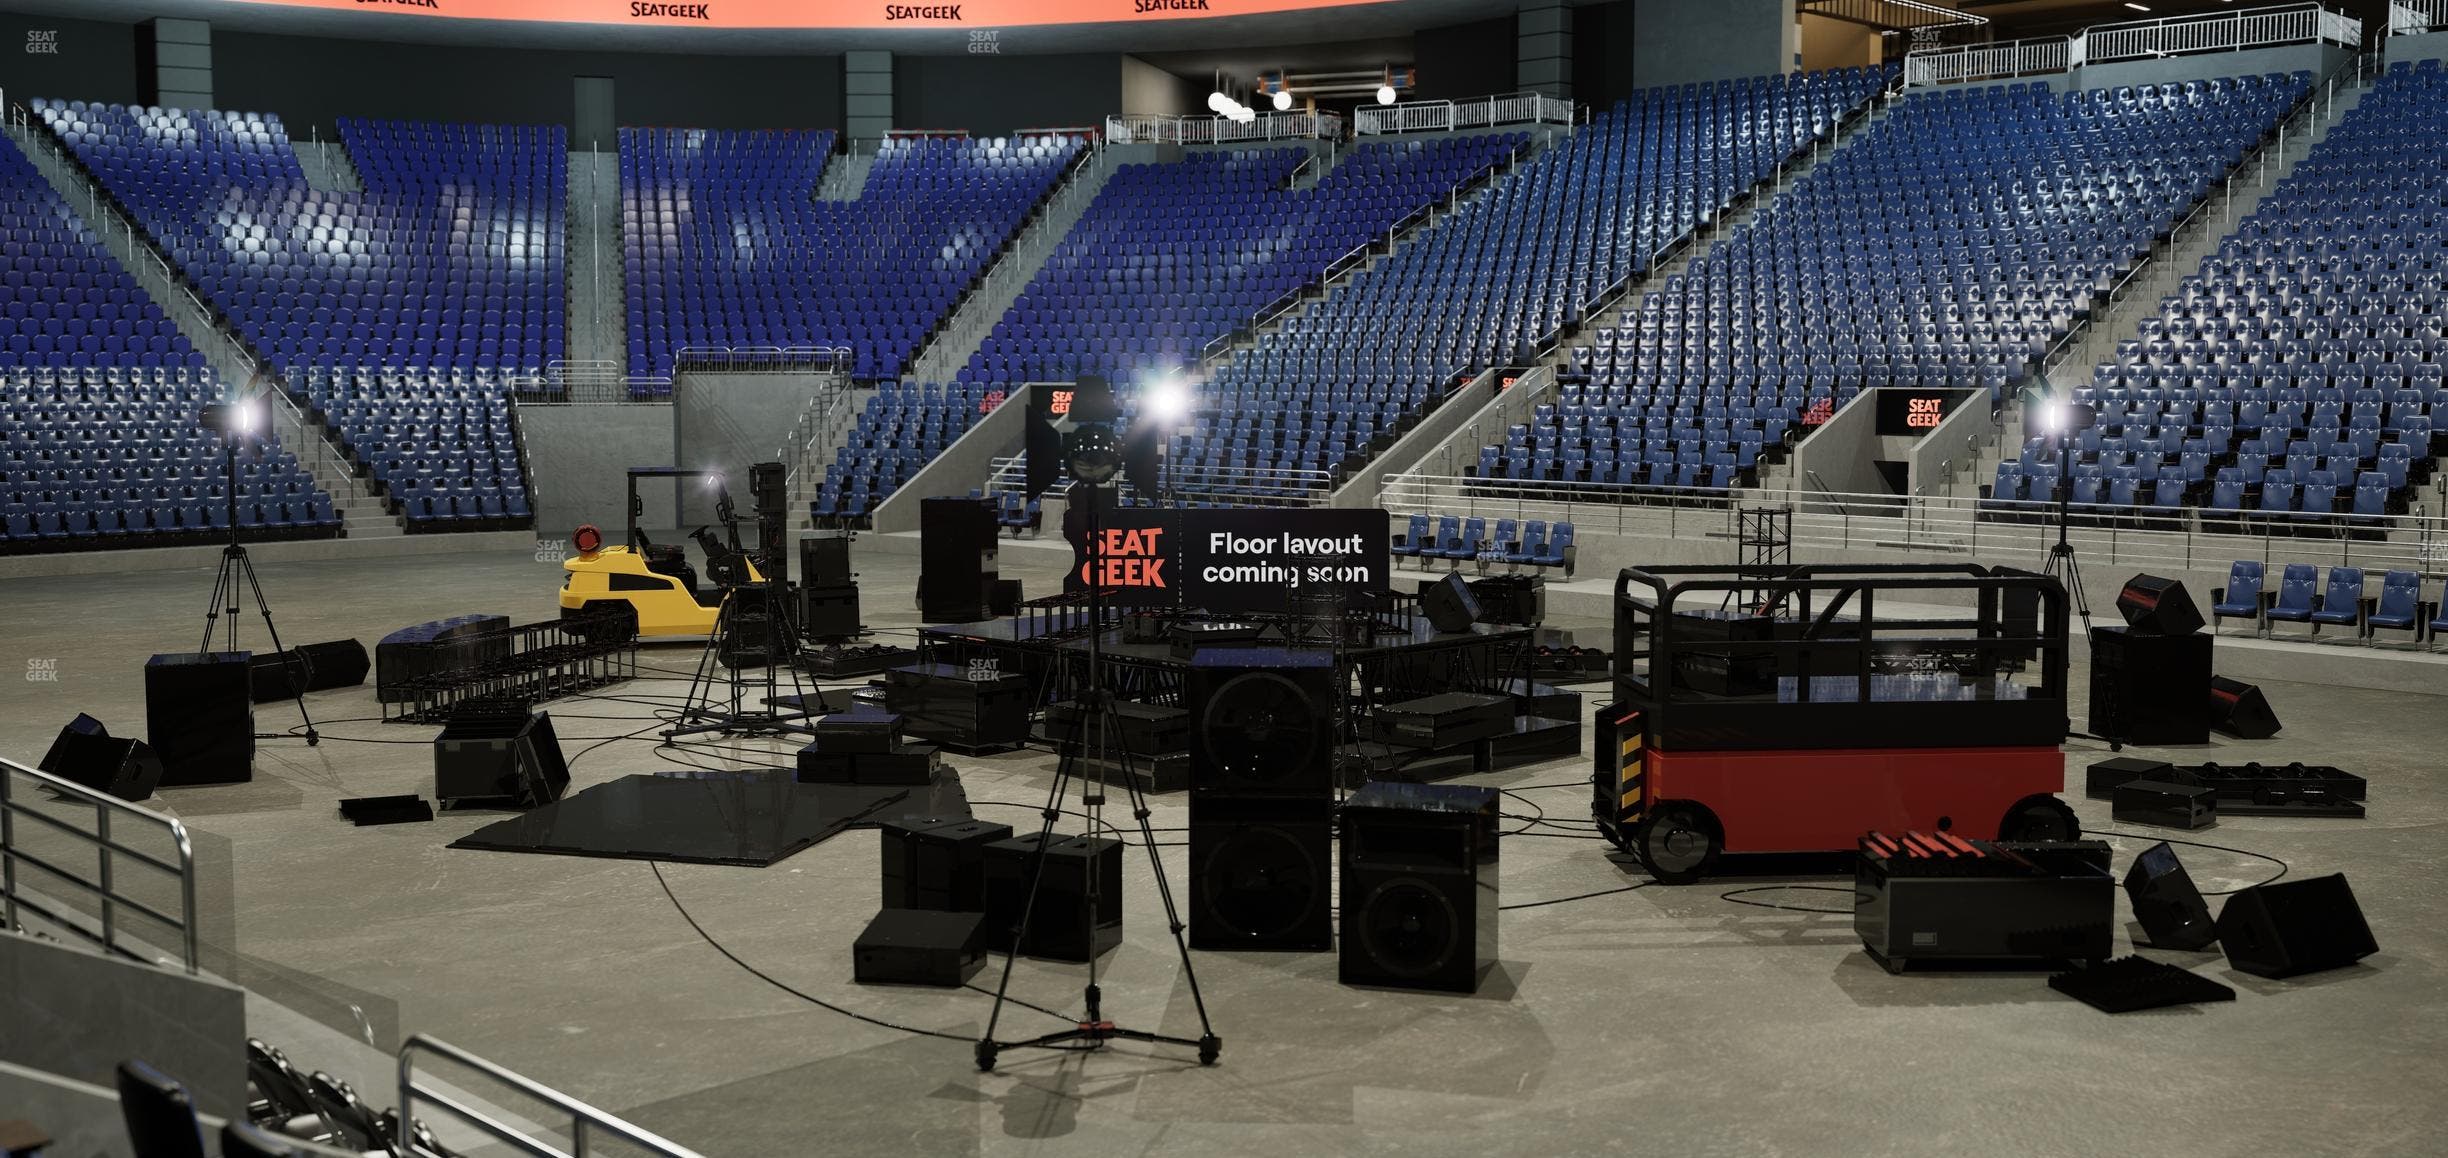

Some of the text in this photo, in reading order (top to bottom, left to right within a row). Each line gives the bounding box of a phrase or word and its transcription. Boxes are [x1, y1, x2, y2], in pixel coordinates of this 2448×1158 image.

[631, 1, 710, 20] SEATGEEK
[886, 4, 962, 20] SEATGEEK
[1135, 0, 1209, 13] SEATGEEK
[1052, 390, 1075, 403] SEA
[1909, 398, 1942, 413] SEAT
[1906, 412, 1942, 427] GEEK
[1210, 532, 1278, 554] Floor
[1081, 558, 1167, 588] GEEK
[1202, 560, 1369, 588] coming soon
